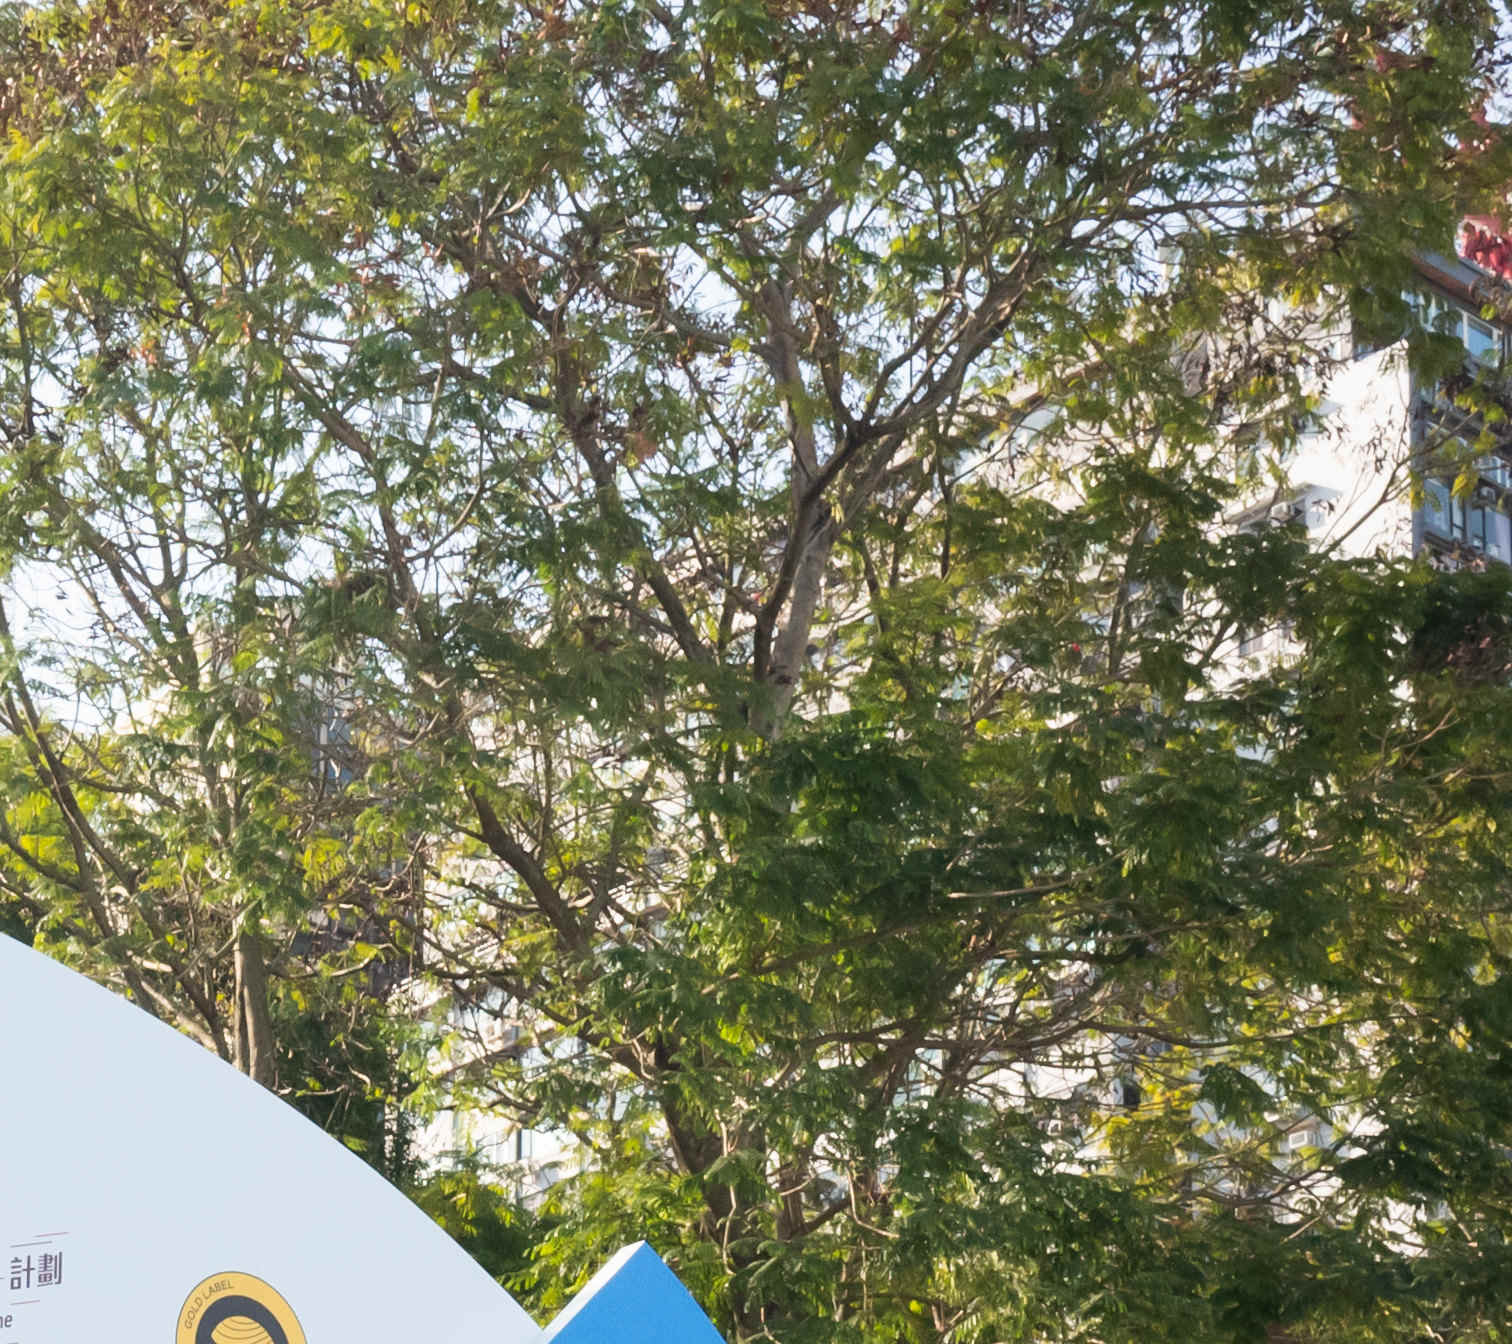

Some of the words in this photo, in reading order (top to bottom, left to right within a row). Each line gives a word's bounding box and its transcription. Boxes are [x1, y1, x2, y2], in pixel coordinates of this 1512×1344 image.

[9, 1251, 64, 1291] 計劃
[184, 1296, 204, 1330] GOLD
[202, 1279, 235, 1301] LABEL
